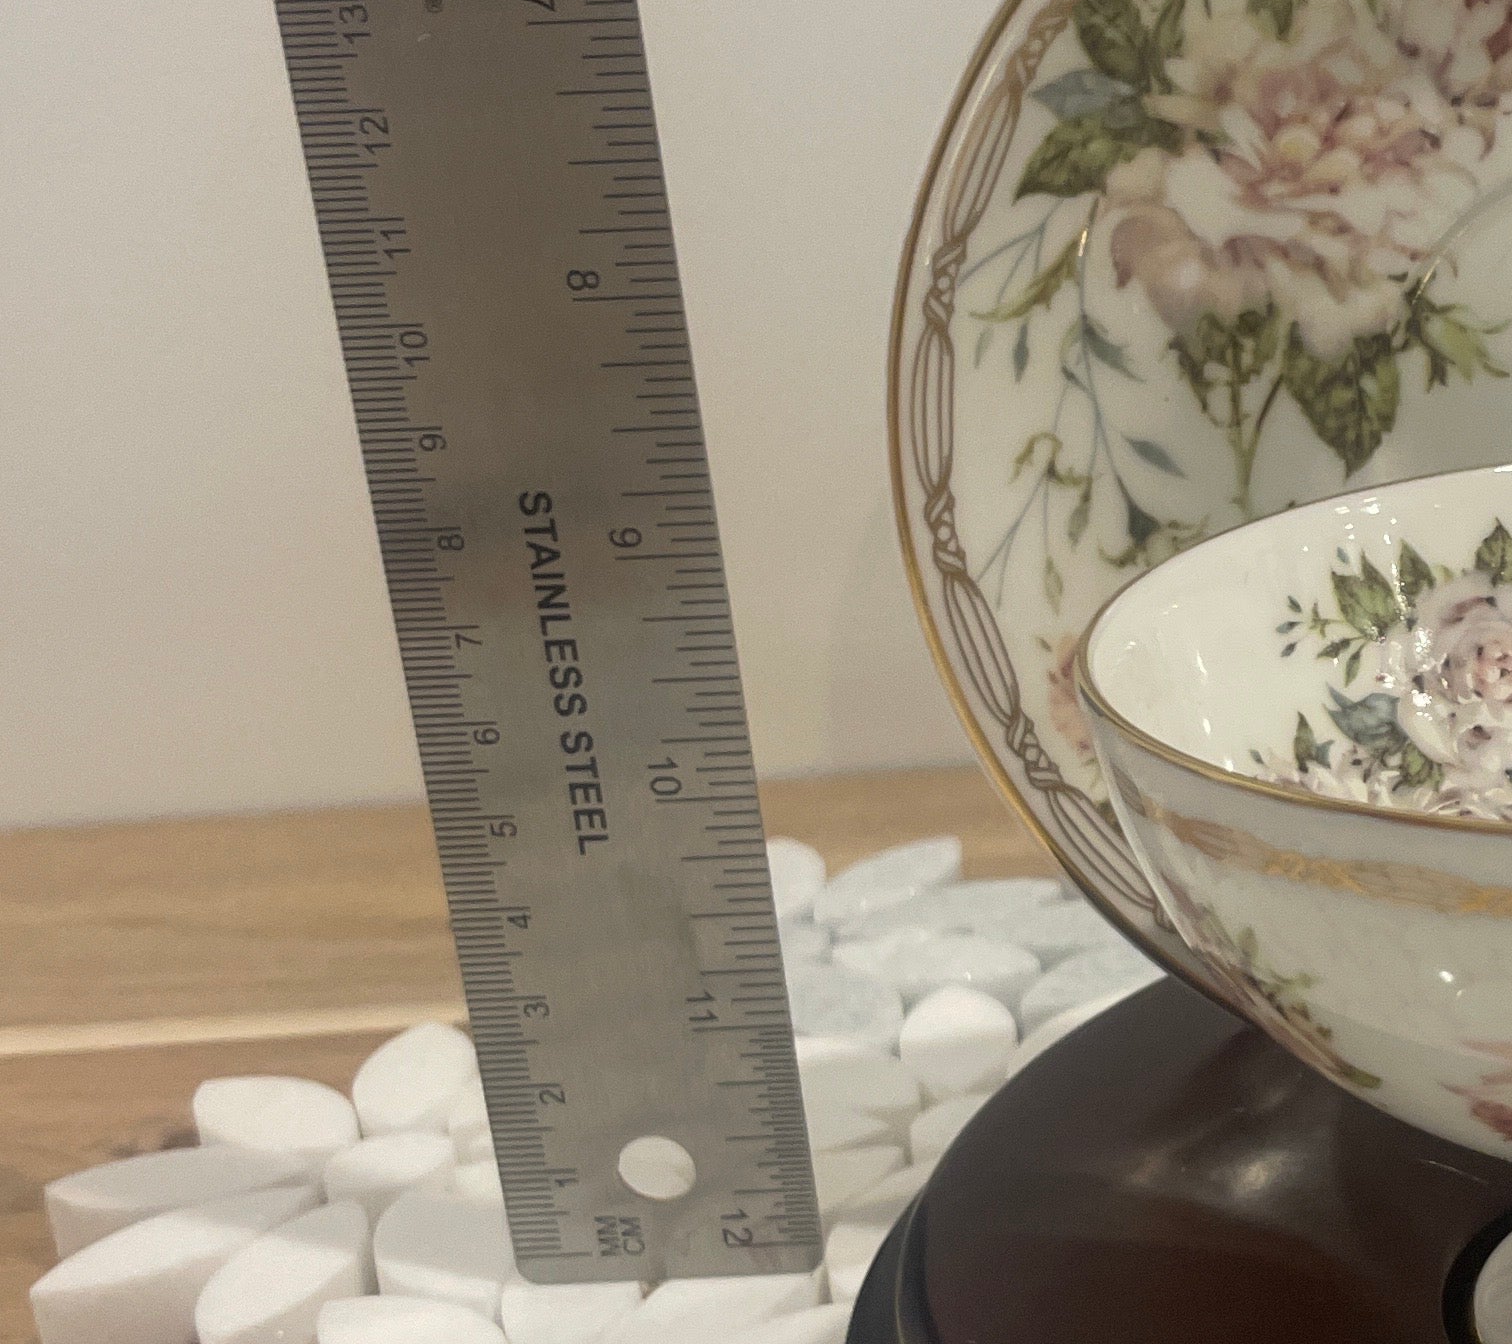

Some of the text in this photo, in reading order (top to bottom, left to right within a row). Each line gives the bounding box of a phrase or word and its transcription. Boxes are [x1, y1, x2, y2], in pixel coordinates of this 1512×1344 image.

[338, 2, 371, 45] 13
[359, 114, 392, 155] 12
[379, 226, 411, 259] 11
[566, 269, 600, 291] 8
[400, 329, 431, 367] 10
[419, 433, 447, 452] 9
[437, 532, 465, 552] 8
[609, 526, 643, 548] 9
[454, 632, 484, 651] 7
[518, 490, 610, 856] STAINLESS STEEL
[473, 727, 500, 746] 6
[647, 756, 683, 796] 10
[490, 820, 518, 838] 5
[507, 912, 532, 930] 4
[523, 1001, 550, 1019] 3
[685, 991, 719, 1024] 11
[539, 1087, 566, 1105] 2
[594, 1215, 620, 1256] MM
[619, 1215, 646, 1255] CM
[720, 1208, 754, 1248] 12
